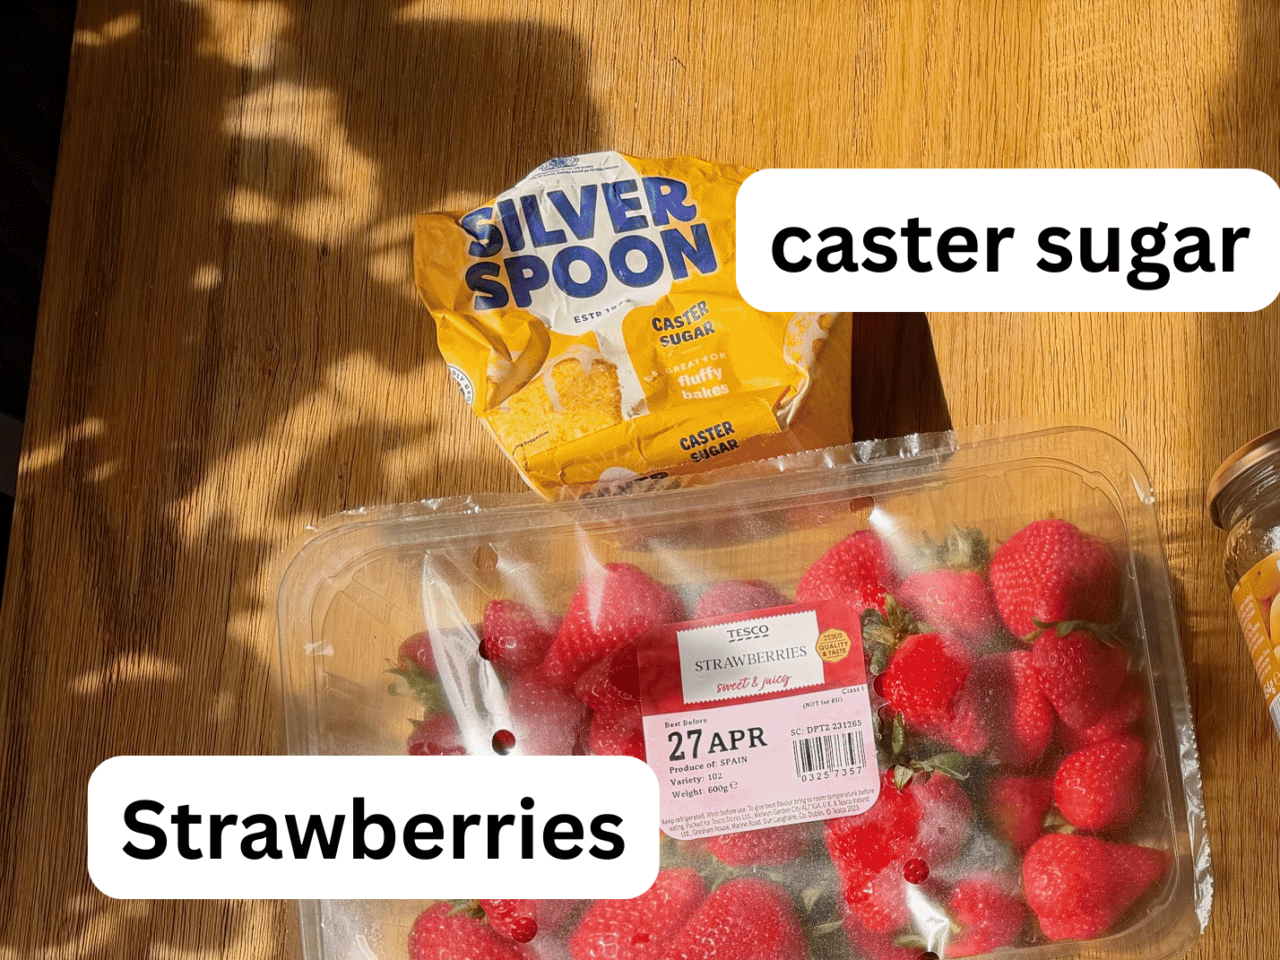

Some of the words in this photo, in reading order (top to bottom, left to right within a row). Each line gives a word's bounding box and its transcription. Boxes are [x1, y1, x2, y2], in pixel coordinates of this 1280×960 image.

[458, 175, 697, 260] SILVER
[465, 221, 718, 312] SPOON
[651, 300, 709, 331] CASTER
[659, 320, 715, 347] SUGAR
[700, 350, 726, 364] FOR
[677, 365, 721, 387] fluffy
[680, 383, 729, 399] bakes
[678, 420, 735, 451] CASTER
[689, 437, 739, 463] SUGAR
[726, 624, 769, 638] TESCO
[818, 641, 848, 650] QUALITY
[828, 647, 846, 655] TASTE
[694, 645, 807, 672] STRAWBERRIES
[715, 676, 751, 693] sweet
[750, 675, 759, 687] &
[755, 672, 793, 691] juicy
[841, 685, 860, 694] Class
[801, 700, 820, 709] (NOT
[663, 720, 681, 729] Best
[682, 716, 707, 726] Before
[790, 727, 804, 736] SC:
[806, 722, 830, 733] DPT2
[831, 718, 862, 730] 231265
[665, 728, 705, 762] 27
[704, 724, 768, 754] APR
[668, 761, 704, 774] Produce
[705, 759, 718, 769] of:
[719, 755, 748, 766] SPAIN
[669, 774, 704, 787] Variety:
[707, 772, 723, 781] 102
[800, 771, 830, 783] 0325
[834, 765, 863, 778] 7357
[671, 786, 706, 800] Weight:
[707, 784, 728, 795] 600g
